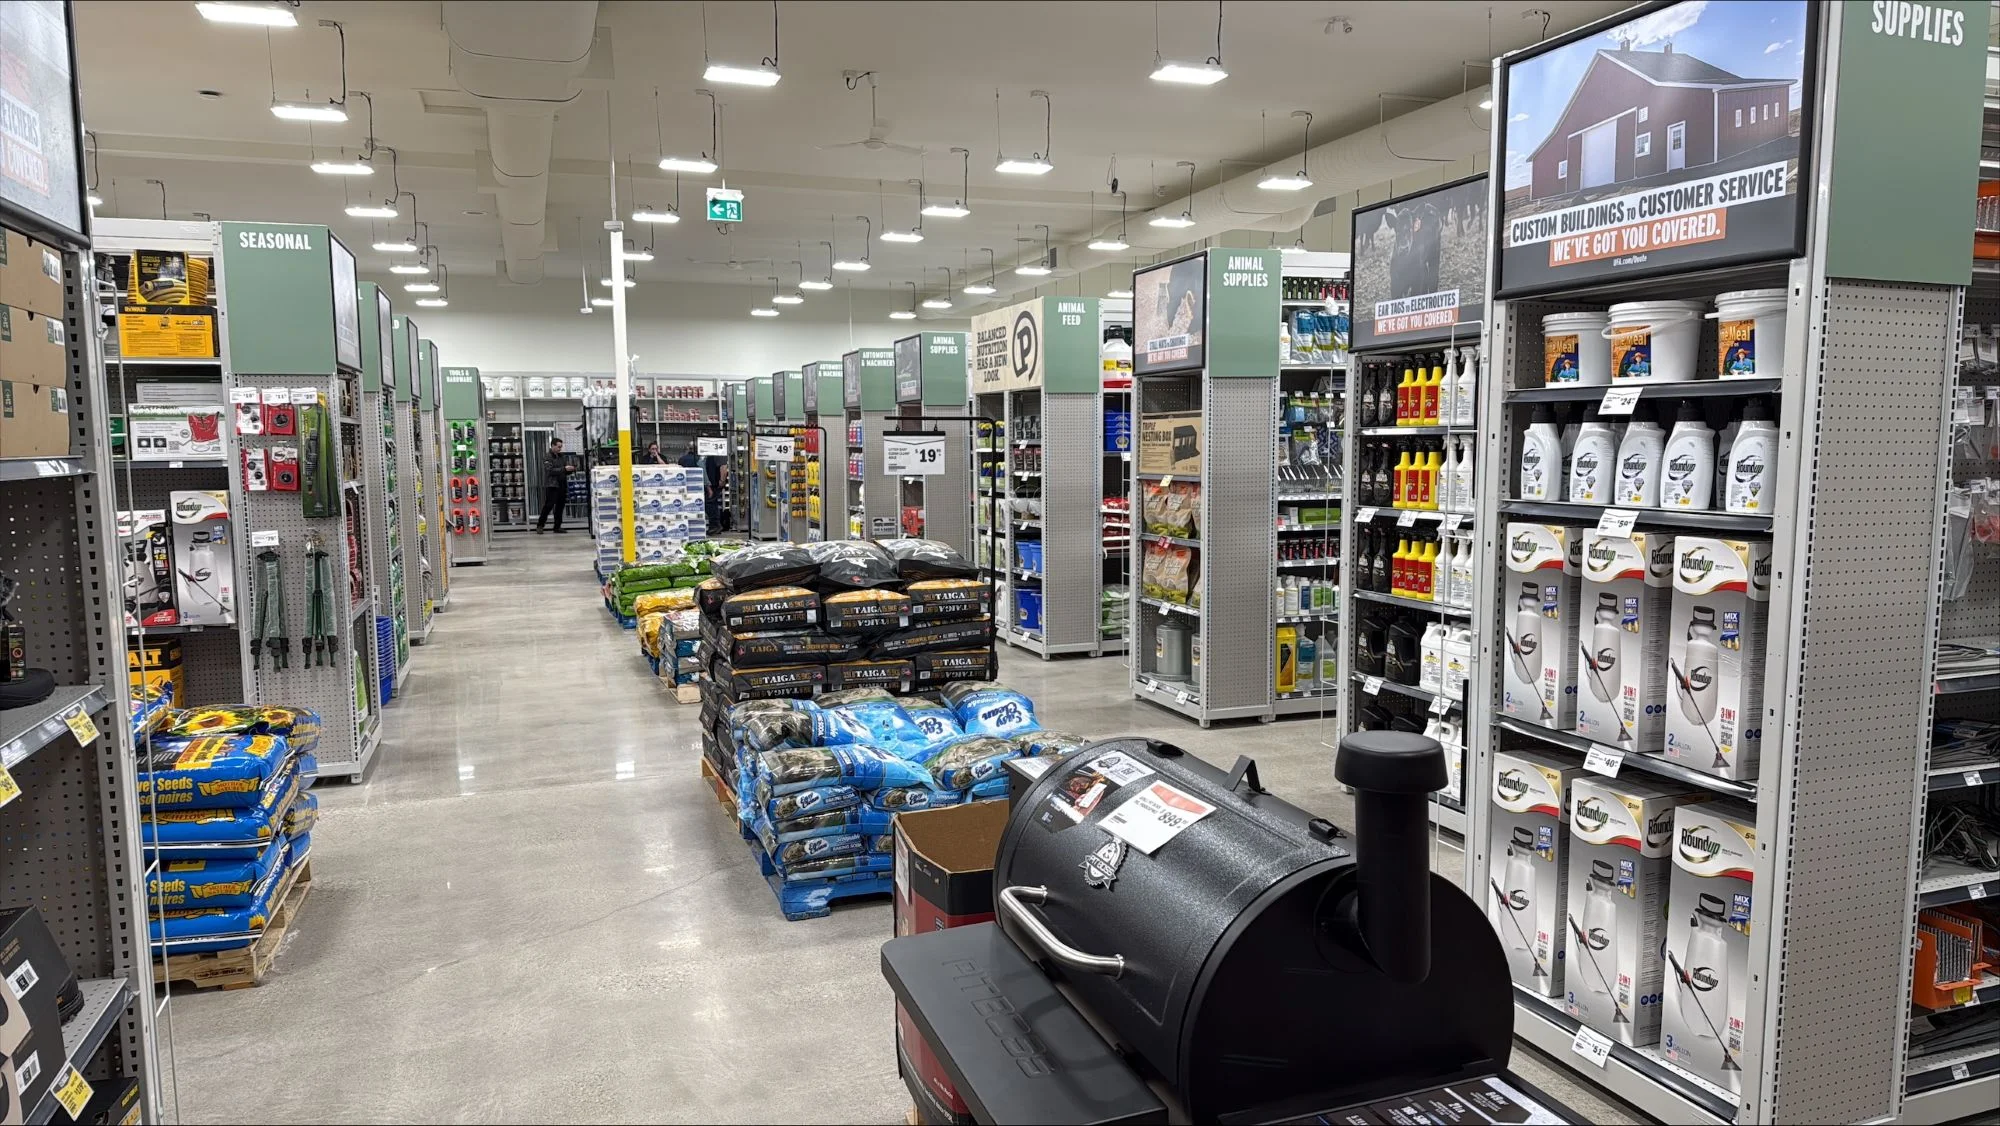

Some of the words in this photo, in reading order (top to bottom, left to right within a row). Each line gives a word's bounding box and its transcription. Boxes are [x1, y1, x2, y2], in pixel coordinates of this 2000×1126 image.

[1871, 1, 1964, 46] SUPPLIES
[1512, 218, 1557, 243] CUSTOM
[1560, 201, 1624, 234] BUILDINGS
[1627, 207, 1636, 220] TO
[1638, 182, 1714, 219] CUSTOMER
[1719, 167, 1784, 205] SERVICE
[239, 231, 312, 250] SEASONAL
[1553, 236, 1590, 262] WE'VE
[1593, 231, 1617, 256] GOT
[1621, 225, 1648, 250] YOU
[1652, 212, 1721, 245] COVERED.
[1228, 256, 1264, 271] ANIMAL
[1223, 272, 1268, 287] SUPPLIES
[1058, 302, 1086, 313] ANIMAL
[1378, 304, 1389, 317] EAR
[1391, 301, 1405, 315] TAGS
[1410, 292, 1456, 312] ELECTROLYTES
[1062, 314, 1081, 325] FEED
[1377, 317, 1396, 333] WE'VE
[1396, 316, 1408, 330] GOT
[1410, 314, 1423, 328] YOU
[1424, 309, 1454, 327] COVERED.
[977, 326, 1006, 344] BALANCED
[1729, 325, 1750, 341] Meal
[933, 336, 955, 345] ANIMAL
[930, 345, 958, 354] SUPPLIES
[977, 339, 1008, 357] NUTRITION
[977, 358, 989, 370] HAS
[988, 357, 993, 368] A
[994, 353, 1007, 367] NEW
[1142, 422, 1156, 431] TRIPLE
[1141, 431, 1161, 442] NESTING
[1162, 431, 1171, 442] BOX
[1736, 460, 1764, 474] Roundup
[1512, 537, 1537, 553] Roundup
[1588, 544, 1616, 561] Roundup
[1681, 552, 1713, 572] Roundup
[934, 592, 965, 600] TAIGA
[755, 602, 789, 612] TAIGA
[854, 605, 882, 614] TAIGA
[1724, 612, 1738, 620] MIX
[750, 645, 778, 653] TAIGA
[943, 658, 972, 666] TAIGA
[762, 674, 796, 684] TAIGA
[856, 669, 886, 678] TAIGA
[1506, 691, 1511, 703] 2
[1579, 710, 1585, 722] 2
[1668, 733, 1674, 746] 2
[157, 776, 193, 792] Seeds
[1498, 771, 1528, 796] Roundup
[158, 791, 193, 804] noires
[1577, 799, 1609, 826] Roundup
[1539, 826, 1552, 835] MIX
[1681, 828, 1721, 858] Roundup
[1096, 860, 1114, 877] BOSS
[1620, 859, 1633, 867] MIX
[1734, 894, 1749, 904] MIX
[1693, 967, 1719, 987] Roundup
[1568, 991, 1574, 1003] 3
[1666, 1034, 1673, 1048] 3
